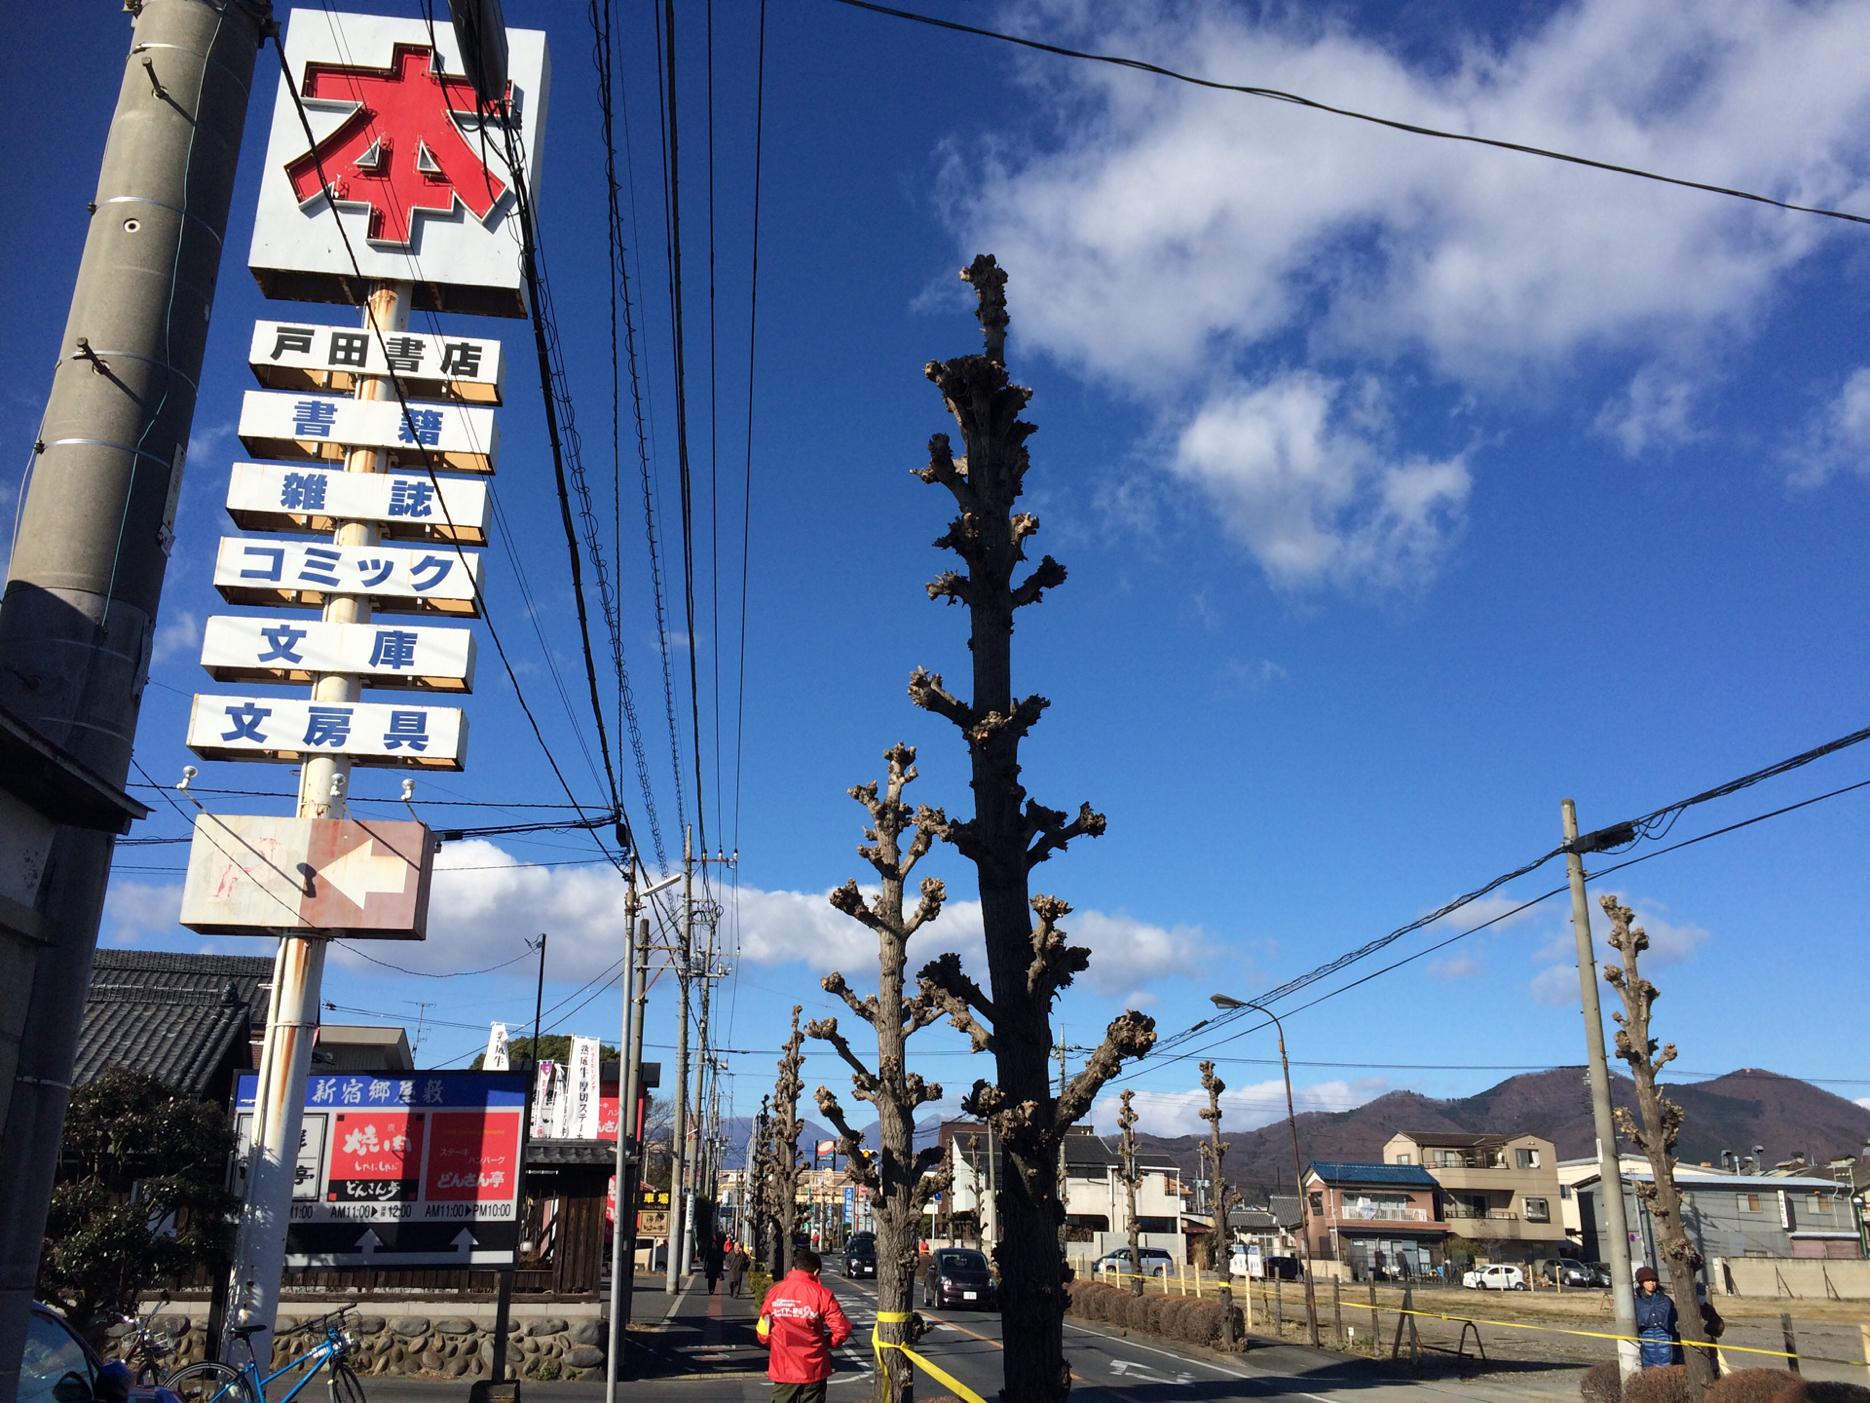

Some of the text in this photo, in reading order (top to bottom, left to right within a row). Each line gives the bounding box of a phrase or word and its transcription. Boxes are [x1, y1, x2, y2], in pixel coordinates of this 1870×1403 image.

[284, 42, 515, 247] 本
[270, 326, 483, 378] 戸田書店
[292, 400, 444, 446] 書籍
[281, 473, 435, 518] 雑誌
[240, 546, 454, 592] コミック
[257, 624, 419, 670] 文庫
[221, 702, 430, 751] 文房具
[342, 1124, 412, 1156] 焼肉
[438, 1171, 505, 1188] どんさん亭
[425, 1204, 511, 1217] AM11:00 PM10:00
